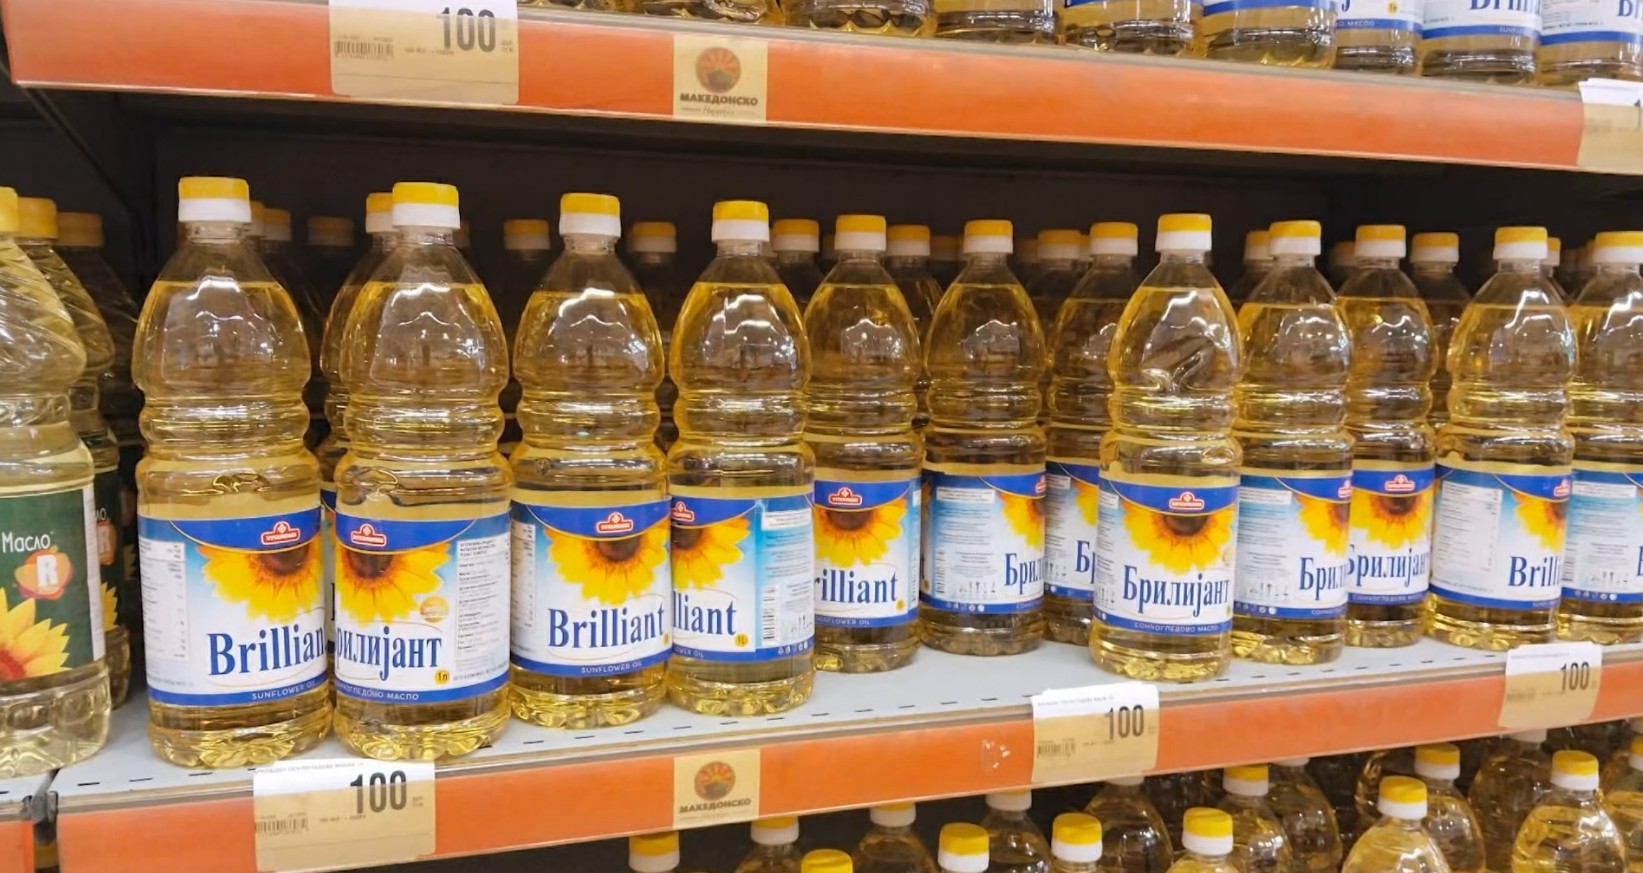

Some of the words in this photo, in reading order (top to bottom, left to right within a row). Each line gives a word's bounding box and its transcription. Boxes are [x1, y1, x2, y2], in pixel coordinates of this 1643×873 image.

[438, 7, 496, 53] 100
[680, 93, 759, 106] МАКЕДОНСКО
[1, 531, 51, 553] Масло
[1123, 565, 1231, 617] Брилијант
[547, 604, 665, 649] Brilliant
[580, 663, 630, 674] SUNFLOWER
[1560, 661, 1590, 691] 100
[251, 684, 305, 701] SUNFLOWER
[386, 692, 419, 702] МАСЛО
[1105, 704, 1145, 740] 100
[349, 770, 407, 815] 100
[679, 798, 752, 814] МАКЕДОНСКО
